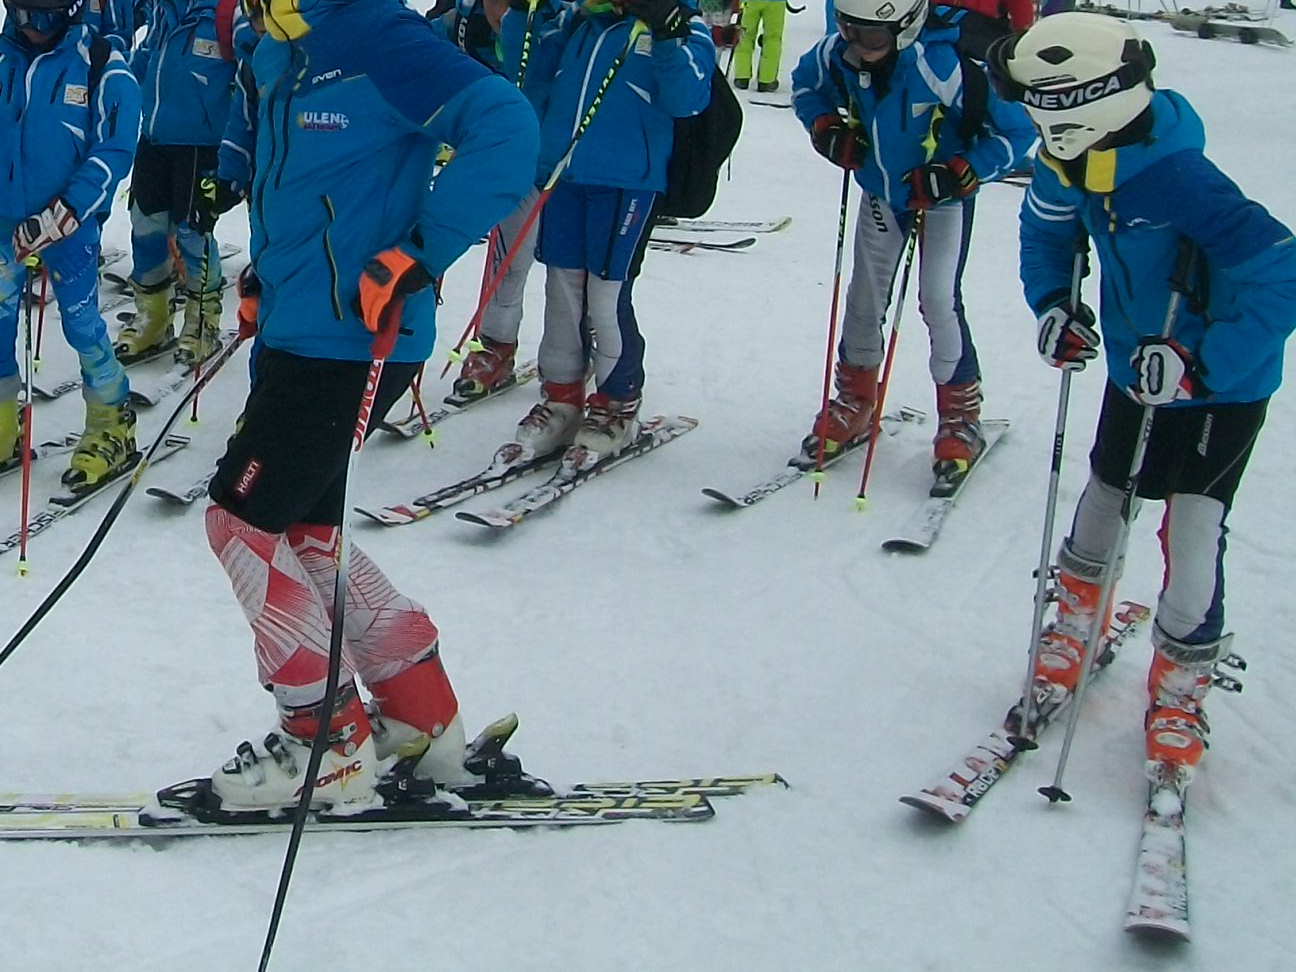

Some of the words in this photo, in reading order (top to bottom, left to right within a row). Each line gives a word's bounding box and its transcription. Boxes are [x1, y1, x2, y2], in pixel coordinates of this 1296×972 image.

[1023, 75, 1121, 108] NEVICA
[303, 111, 342, 124] ULEN
[868, 192, 889, 233] sson
[237, 461, 260, 494] HALTI
